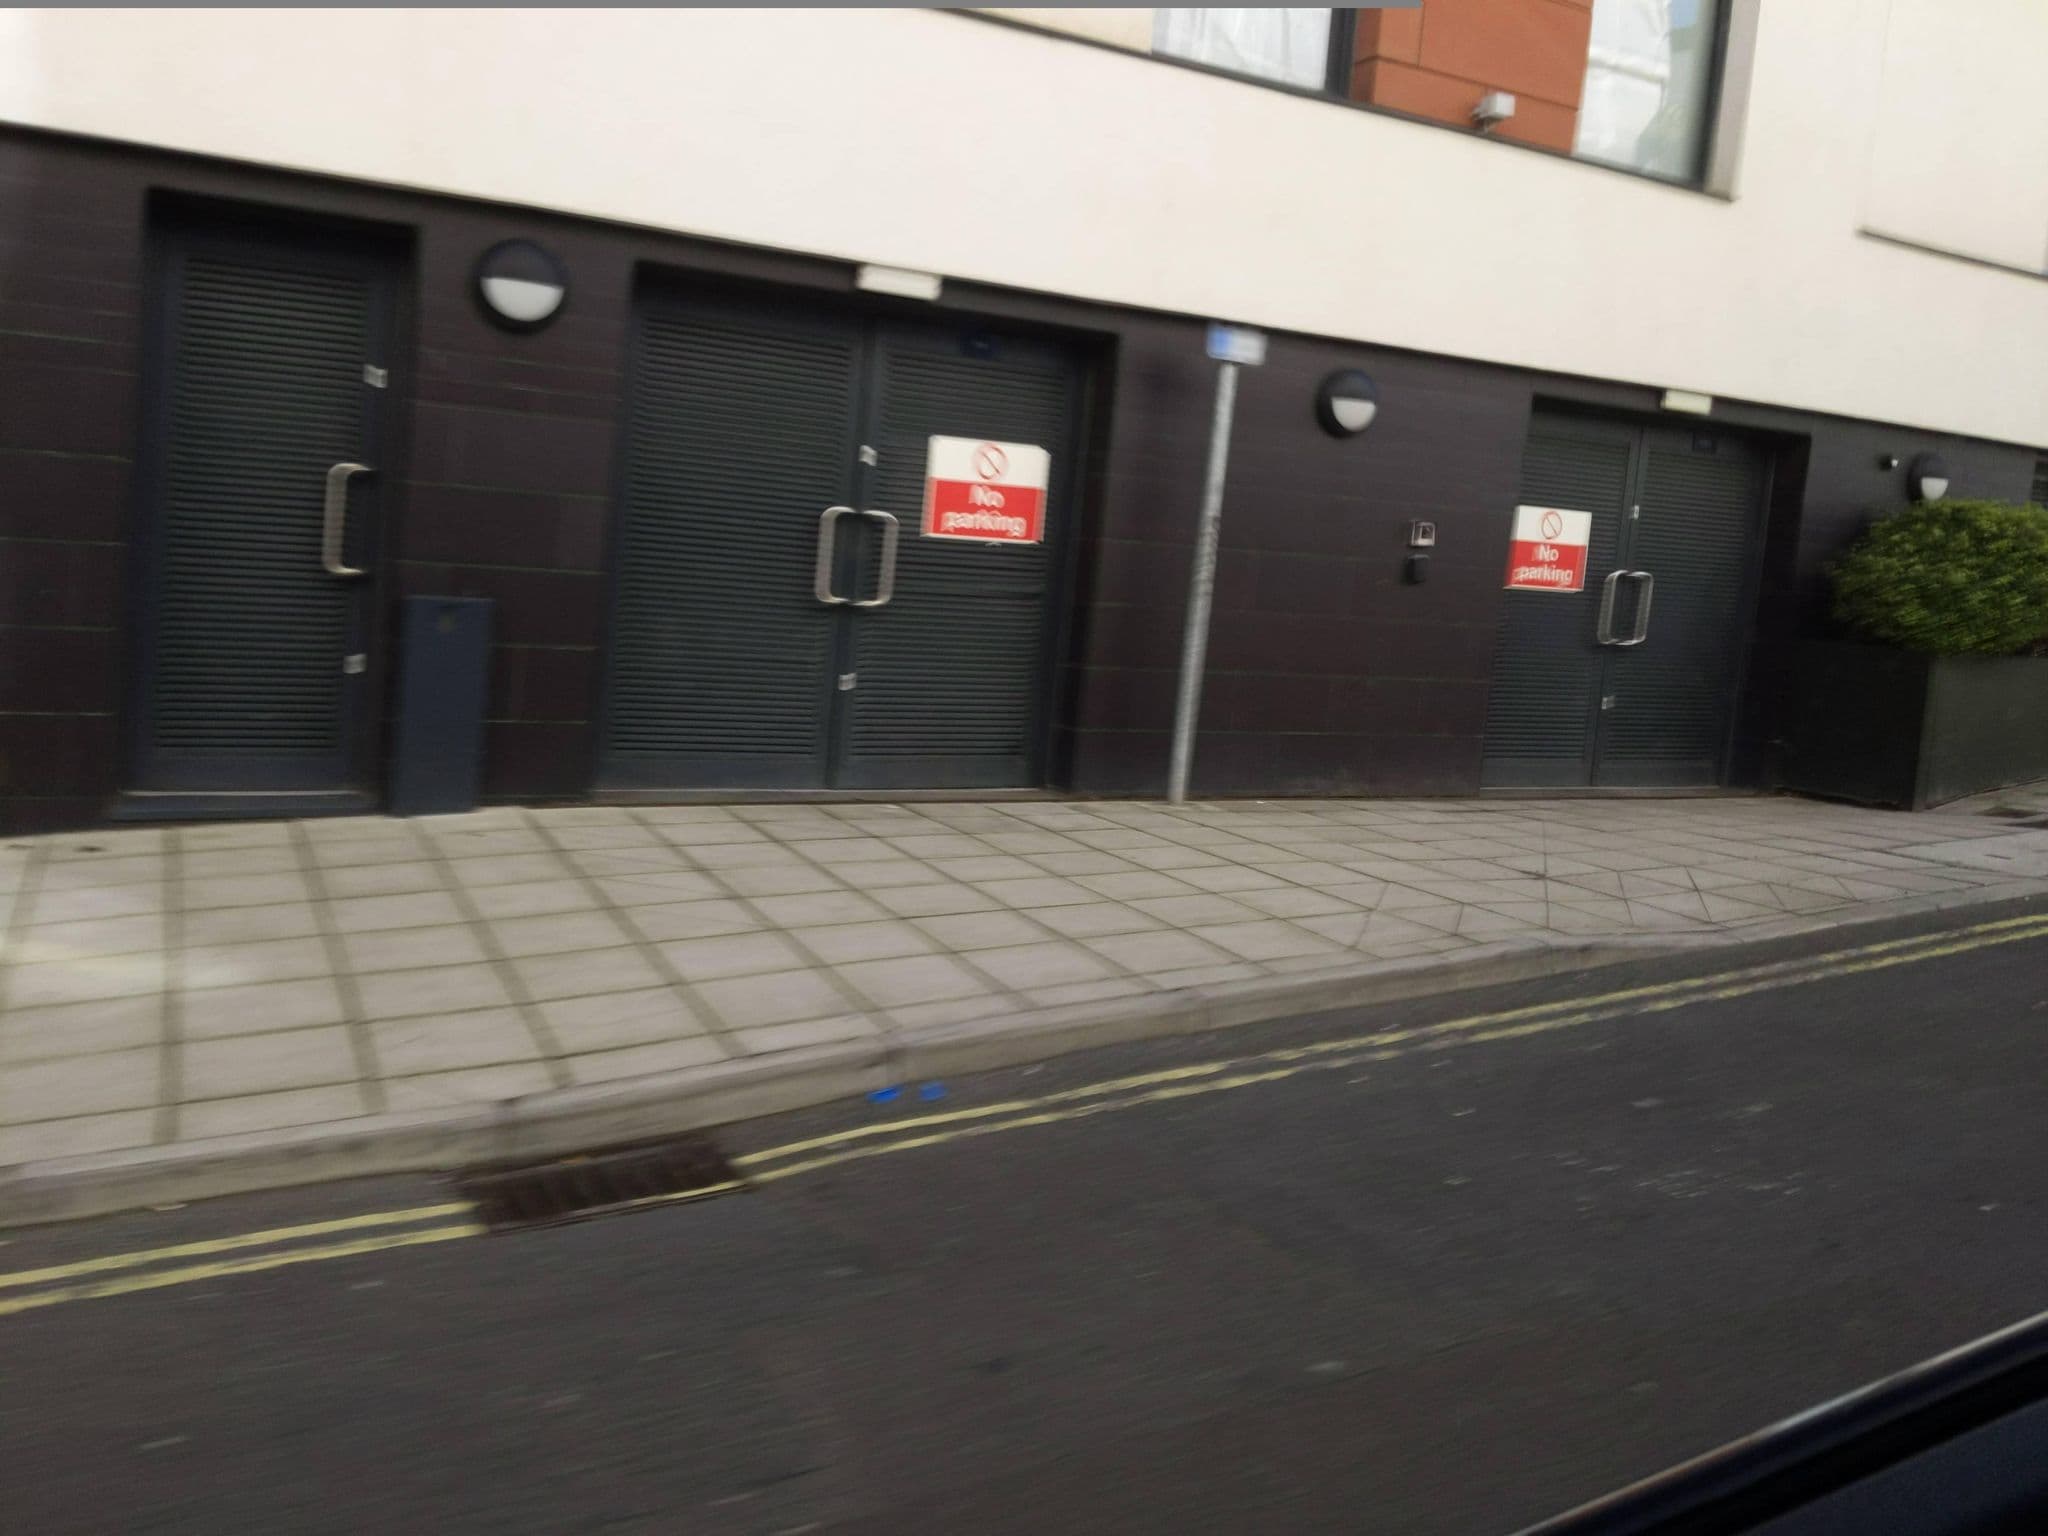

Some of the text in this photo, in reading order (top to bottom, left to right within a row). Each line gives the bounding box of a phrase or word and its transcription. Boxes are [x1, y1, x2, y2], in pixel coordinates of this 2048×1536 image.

[969, 484, 1005, 508] No
[941, 509, 1027, 537] parking
[1535, 544, 1559, 562] No
[1511, 564, 1573, 586] parking
